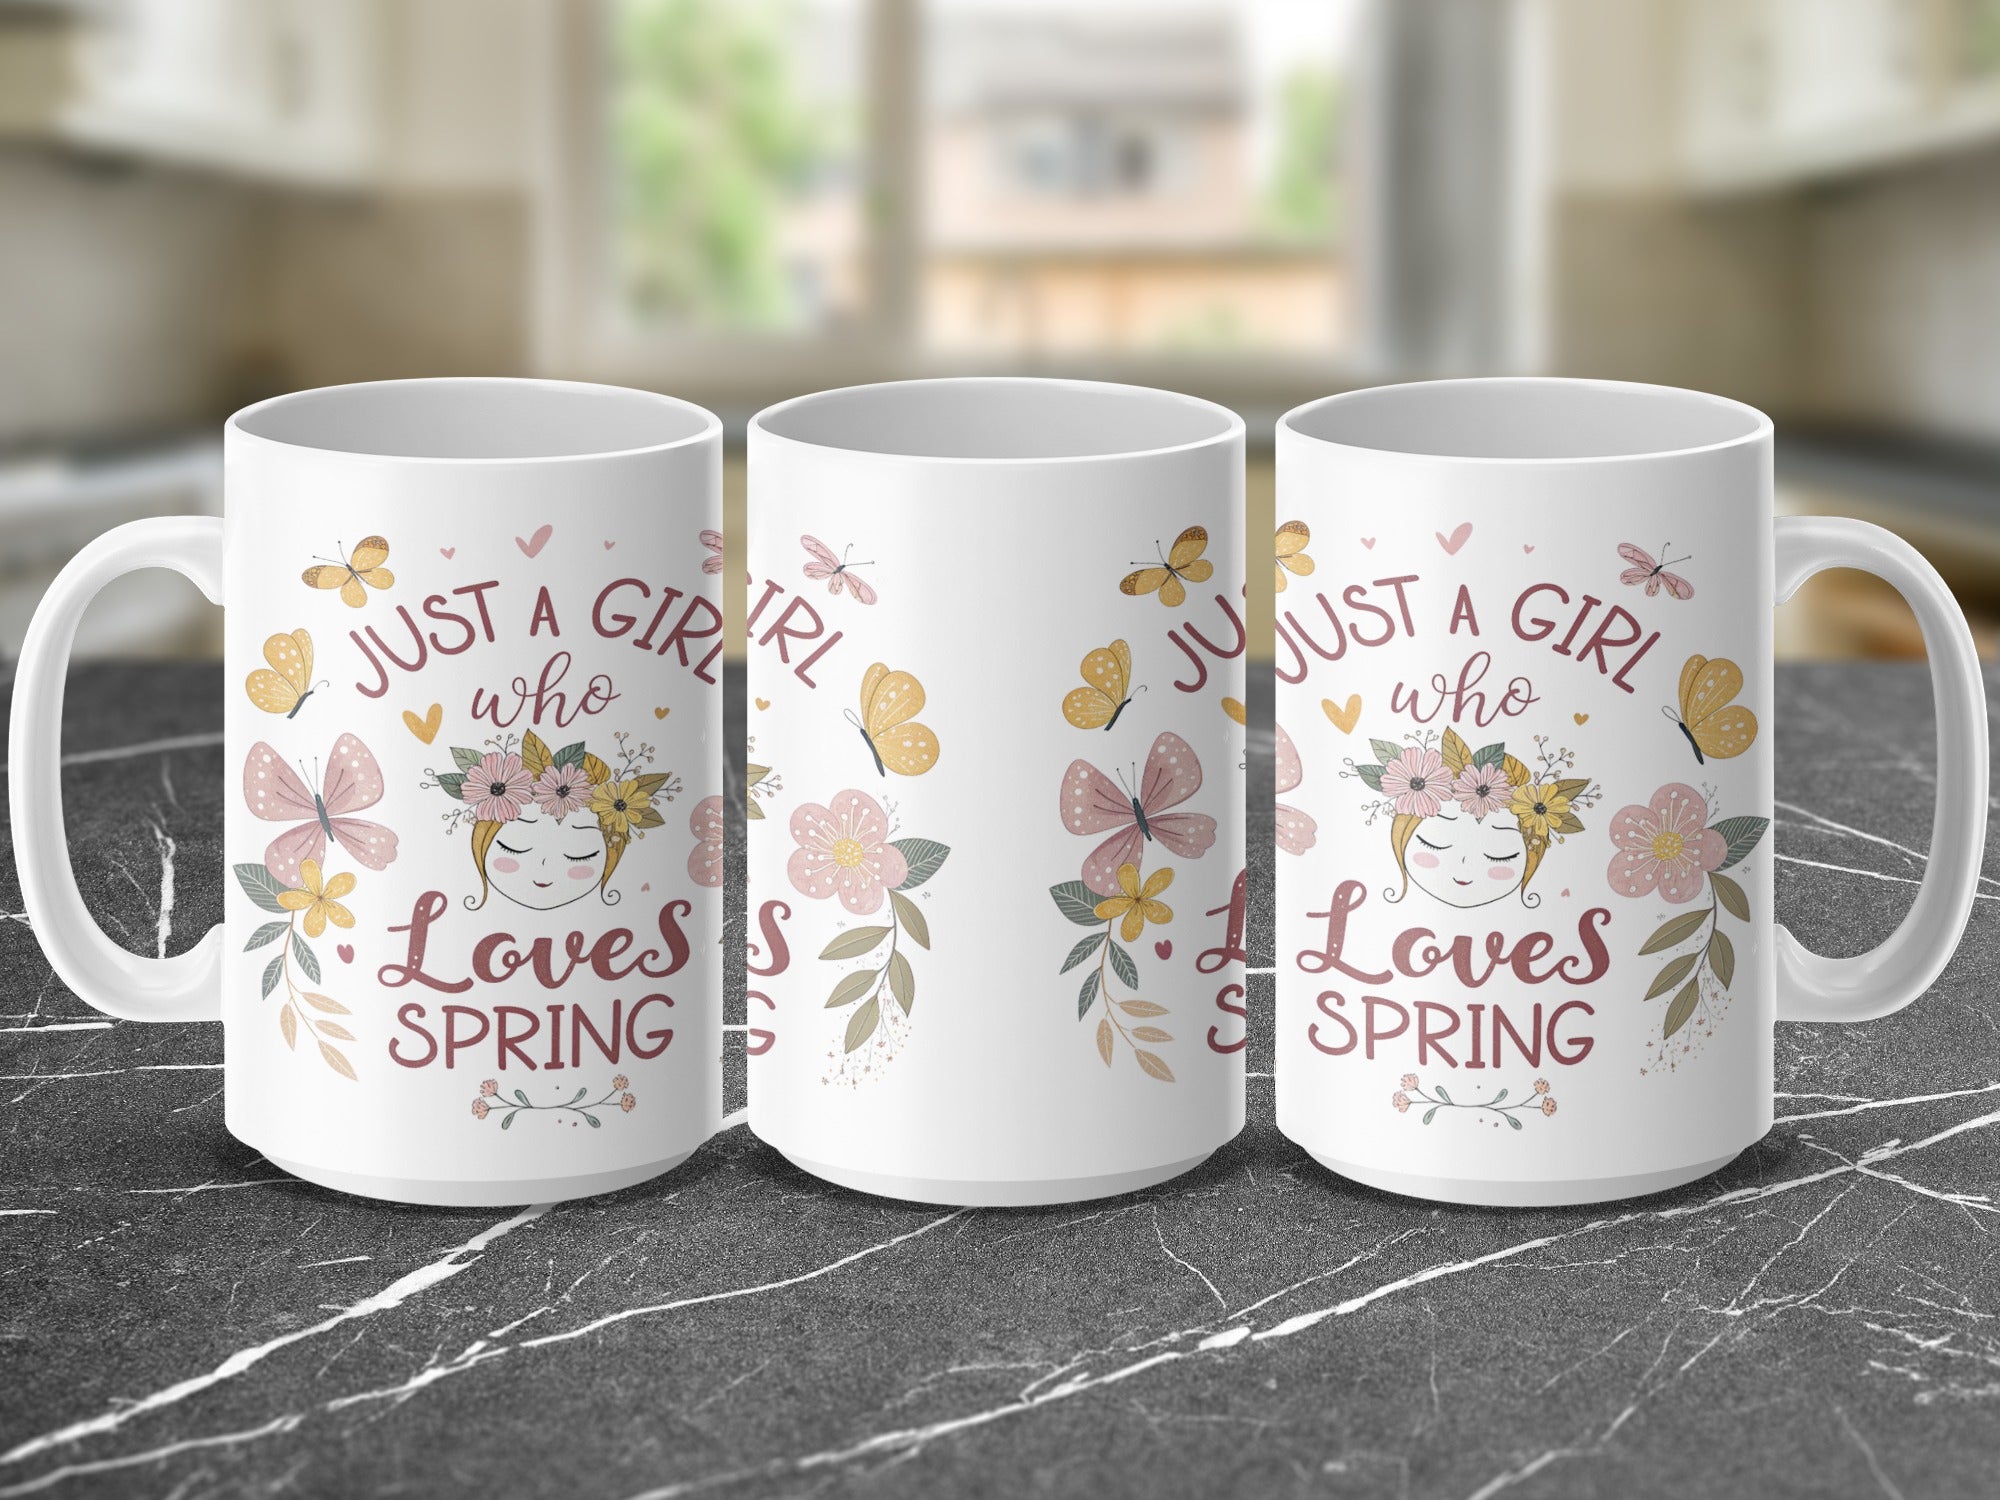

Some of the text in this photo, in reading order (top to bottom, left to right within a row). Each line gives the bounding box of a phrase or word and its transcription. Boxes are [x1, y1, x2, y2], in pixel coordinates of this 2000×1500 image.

[348, 580, 500, 699] JUST
[529, 585, 561, 638] A
[747, 570, 844, 690] IRL
[1167, 584, 1246, 693] JU
[1275, 575, 1661, 694] JUST A GIRL
[470, 651, 621, 728] who
[1390, 651, 1541, 727] who
[388, 993, 676, 1072] SPRING
[1307, 990, 1595, 1069] SPRING
